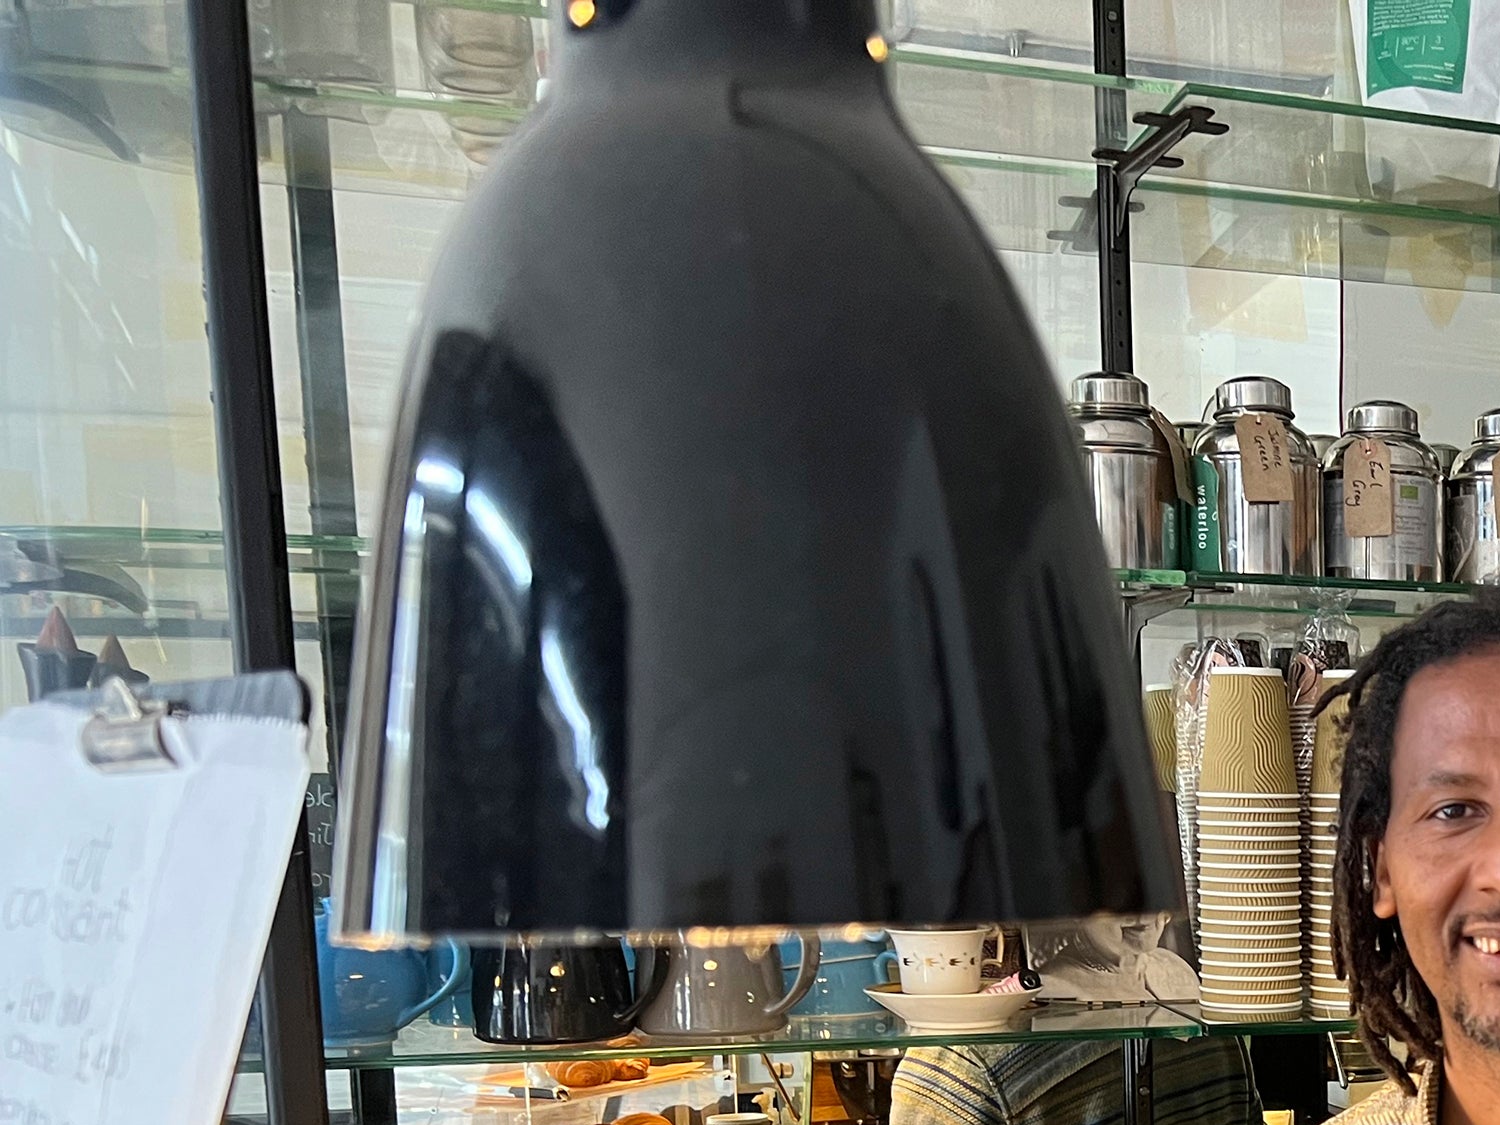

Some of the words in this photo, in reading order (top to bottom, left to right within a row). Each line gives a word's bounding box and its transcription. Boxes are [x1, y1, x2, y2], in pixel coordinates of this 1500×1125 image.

[1253, 434, 1269, 471] Green
[1368, 460, 1384, 489] Earl
[1196, 484, 1209, 549] waterloo
